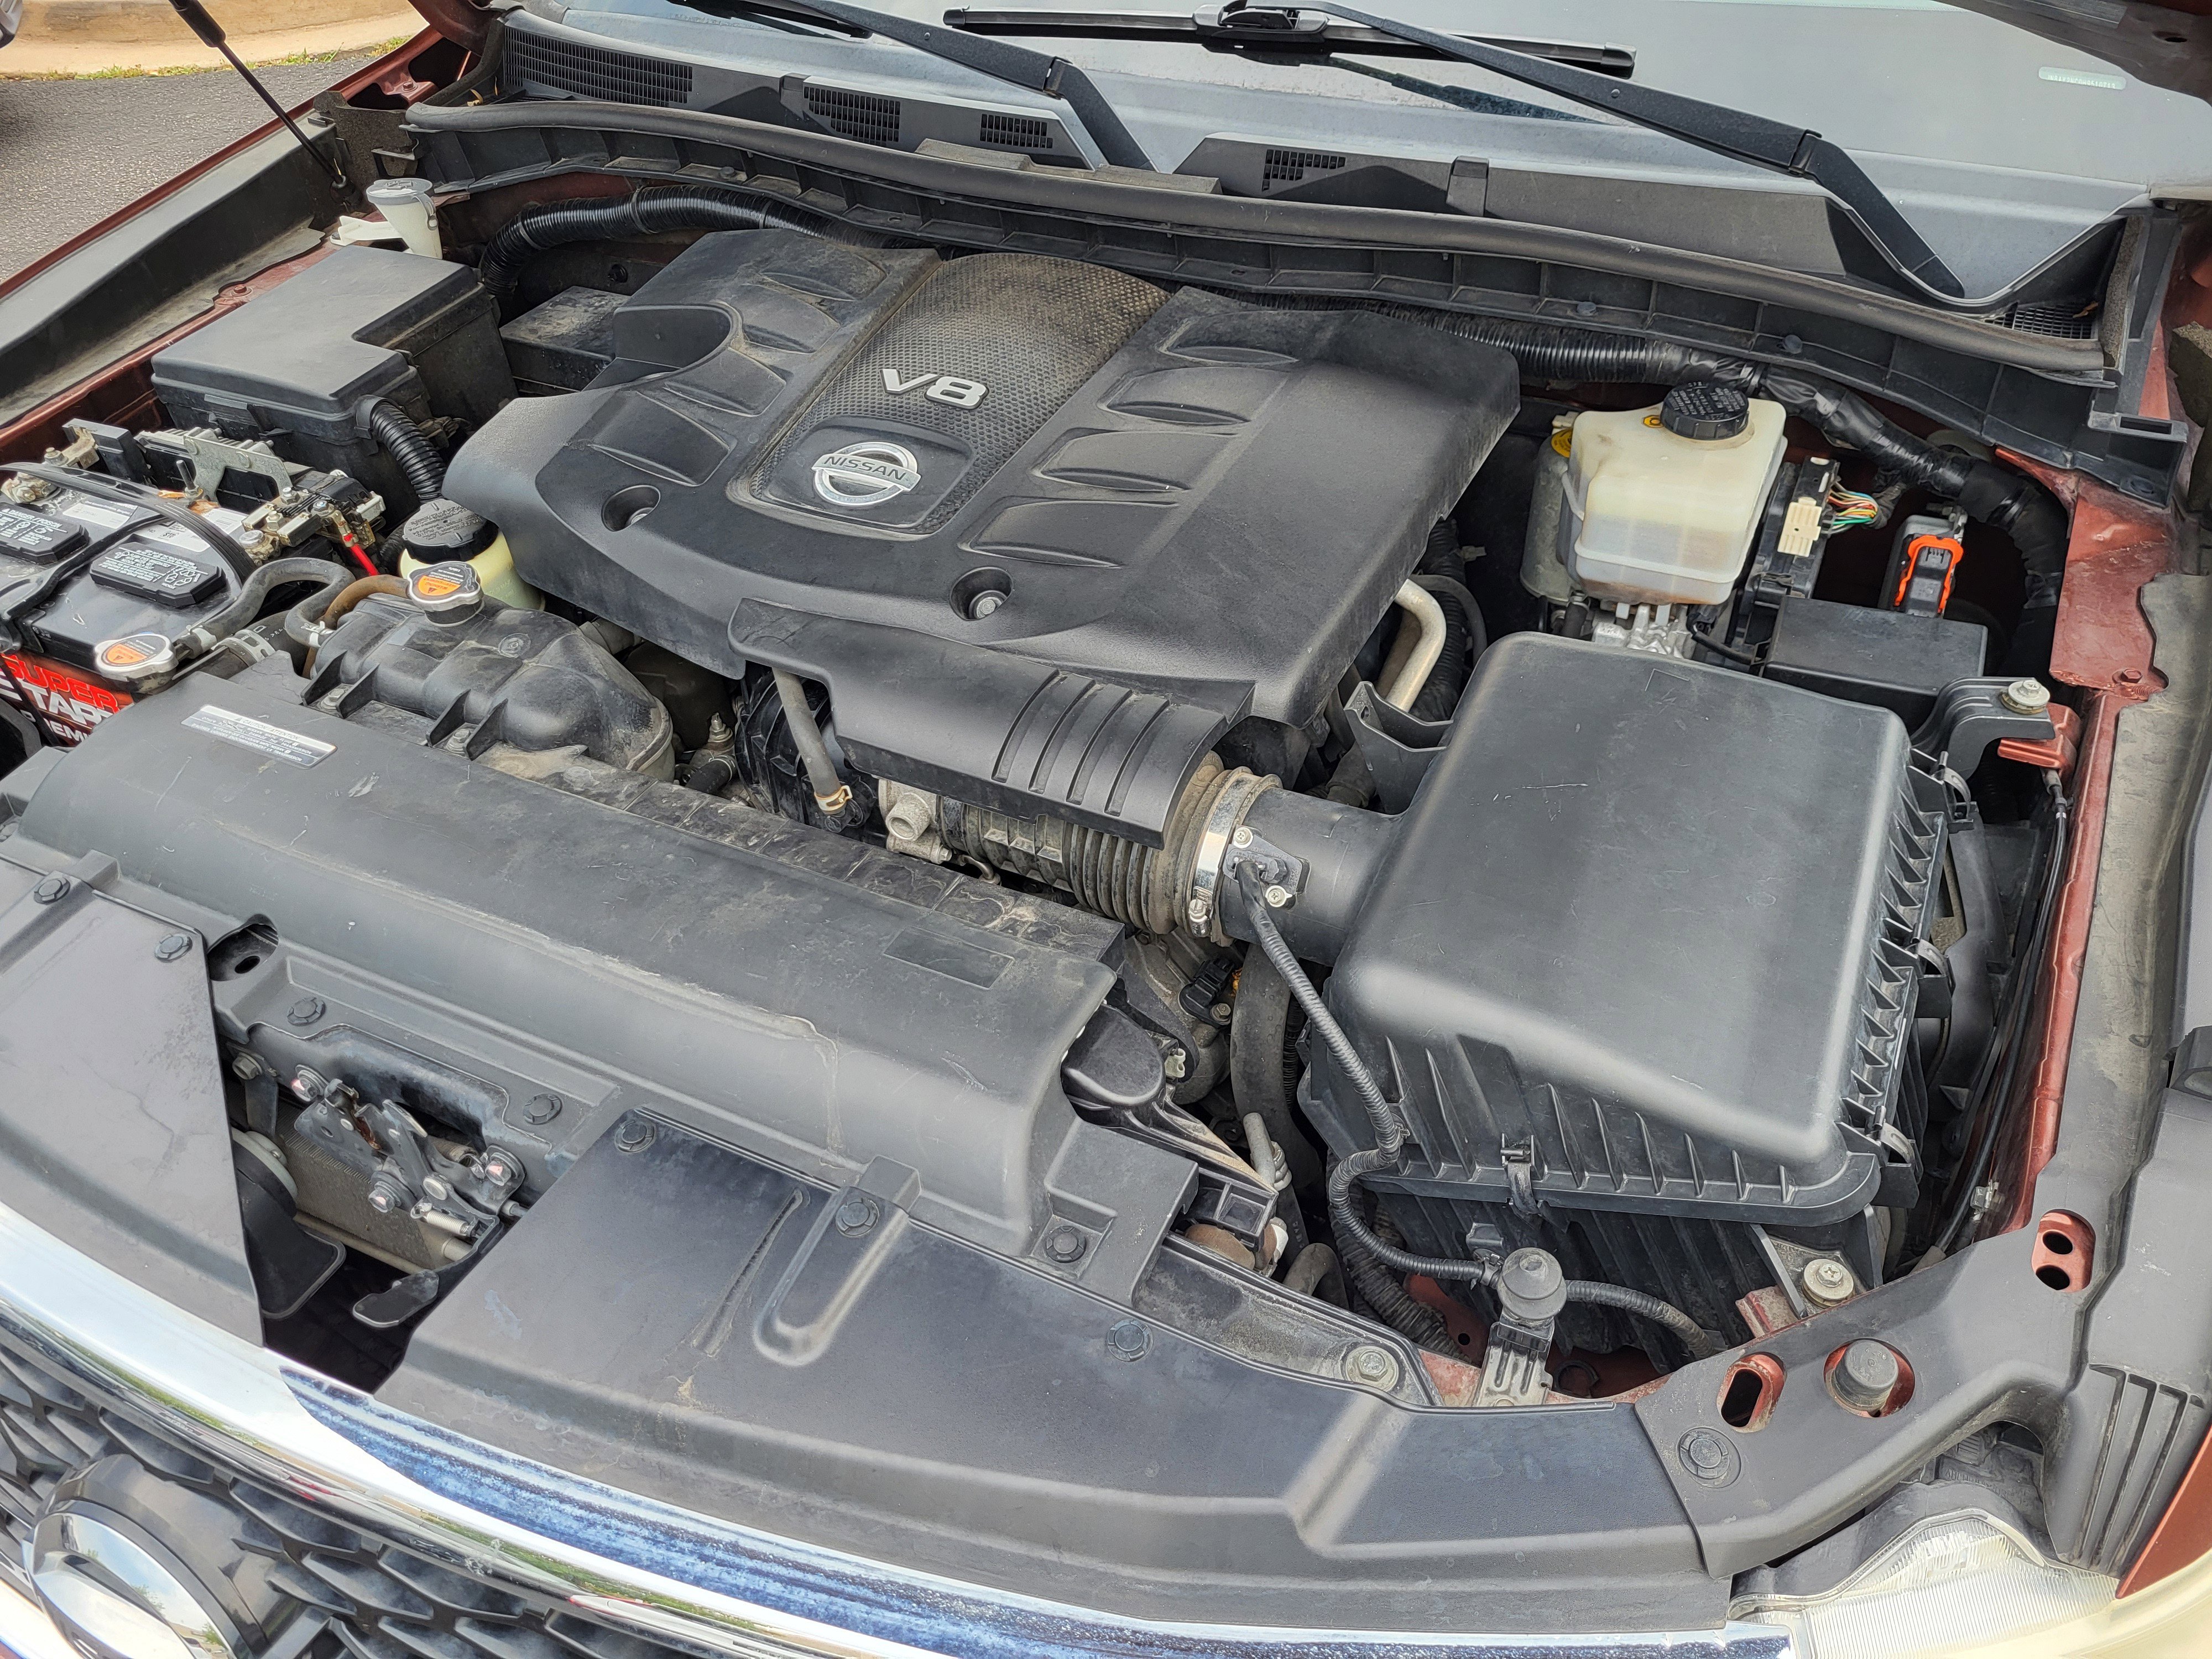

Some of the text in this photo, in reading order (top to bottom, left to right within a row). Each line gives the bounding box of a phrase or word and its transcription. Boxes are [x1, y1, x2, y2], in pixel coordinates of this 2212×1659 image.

[881, 369, 988, 408] V8
[824, 456, 906, 481] NISSAN
[2, 654, 120, 714] SUPER
